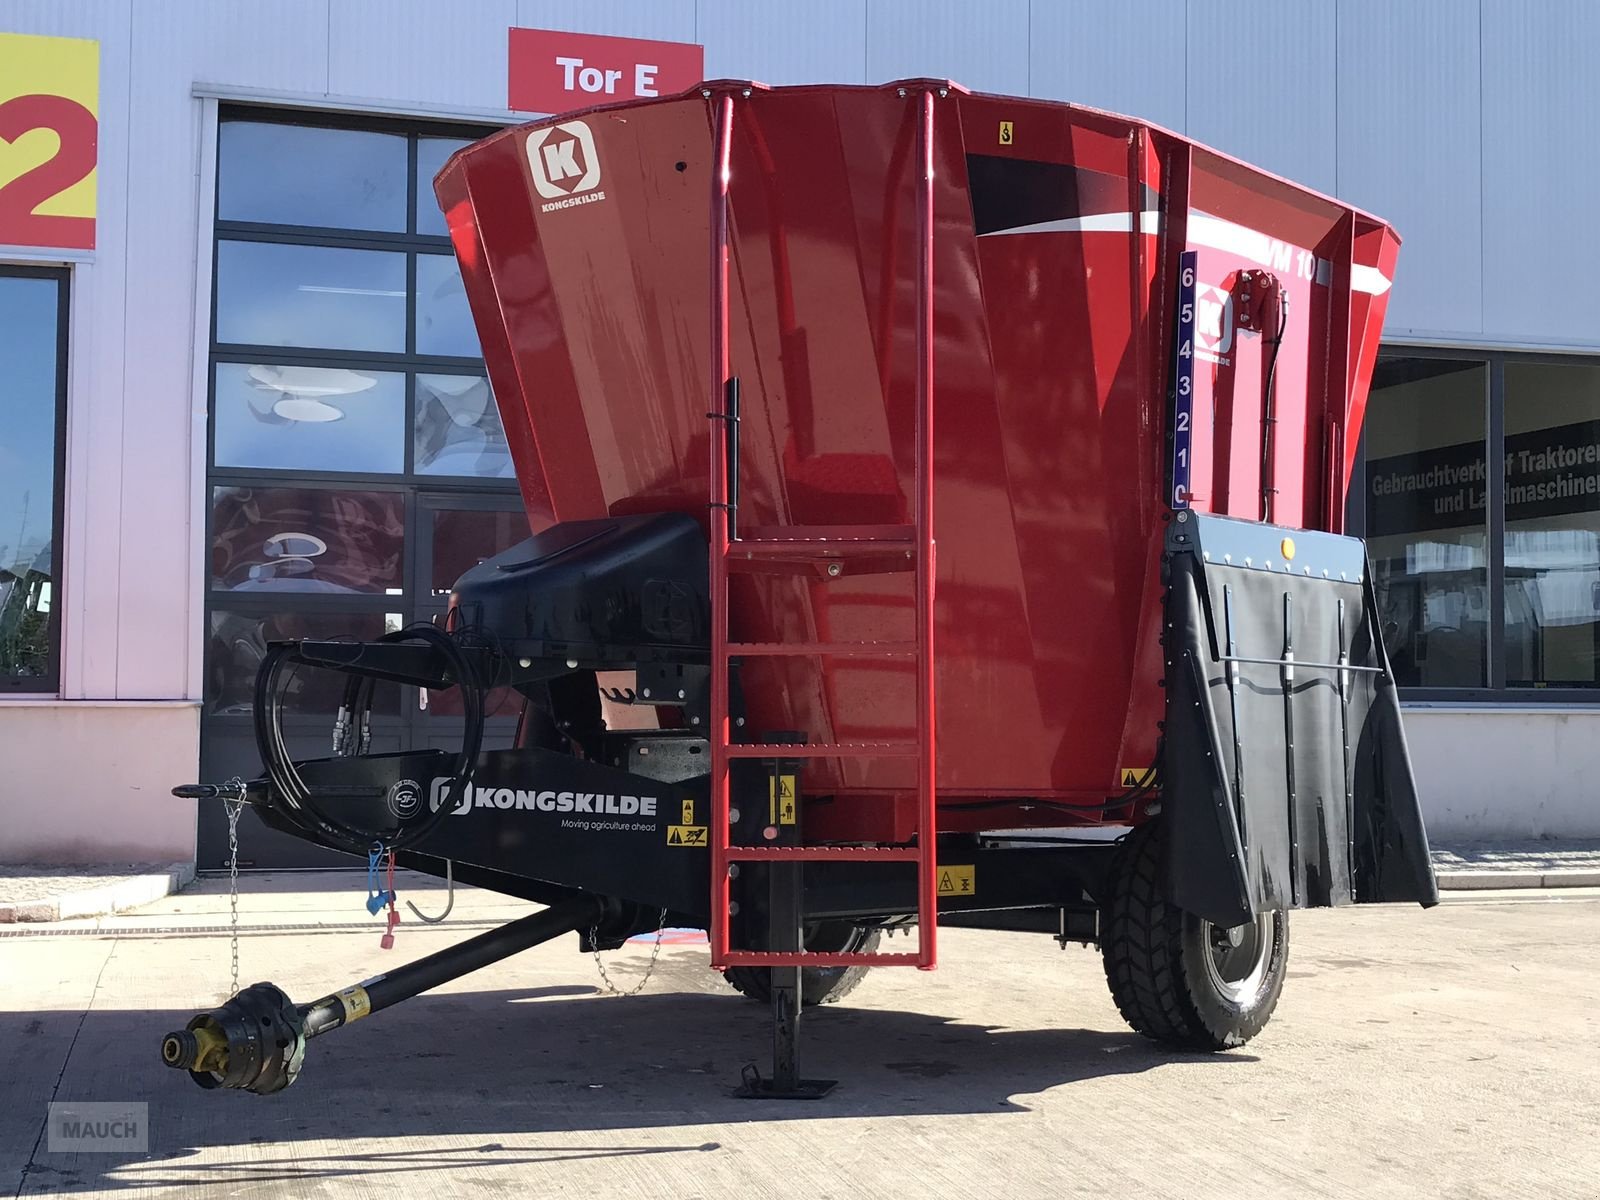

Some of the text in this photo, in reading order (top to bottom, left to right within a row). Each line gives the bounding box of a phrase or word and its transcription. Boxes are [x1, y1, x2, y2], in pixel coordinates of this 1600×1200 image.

[556, 56, 658, 97] Tor E
[0, 94, 97, 249] 2
[541, 191, 606, 213] KONGSKILDE
[1182, 267, 1194, 287] 6
[1181, 303, 1193, 323] 5
[1179, 339, 1192, 359] 4
[1179, 375, 1191, 396] 3
[1177, 411, 1189, 432] 2
[1178, 447, 1187, 468] 1
[1372, 452, 1514, 497] Gebrauchtverkf
[1174, 484, 1187, 504] 0
[1434, 489, 1464, 514] und
[474, 787, 657, 816] KONGSKILDE
[561, 819, 656, 832] Moving agriculture ahead
